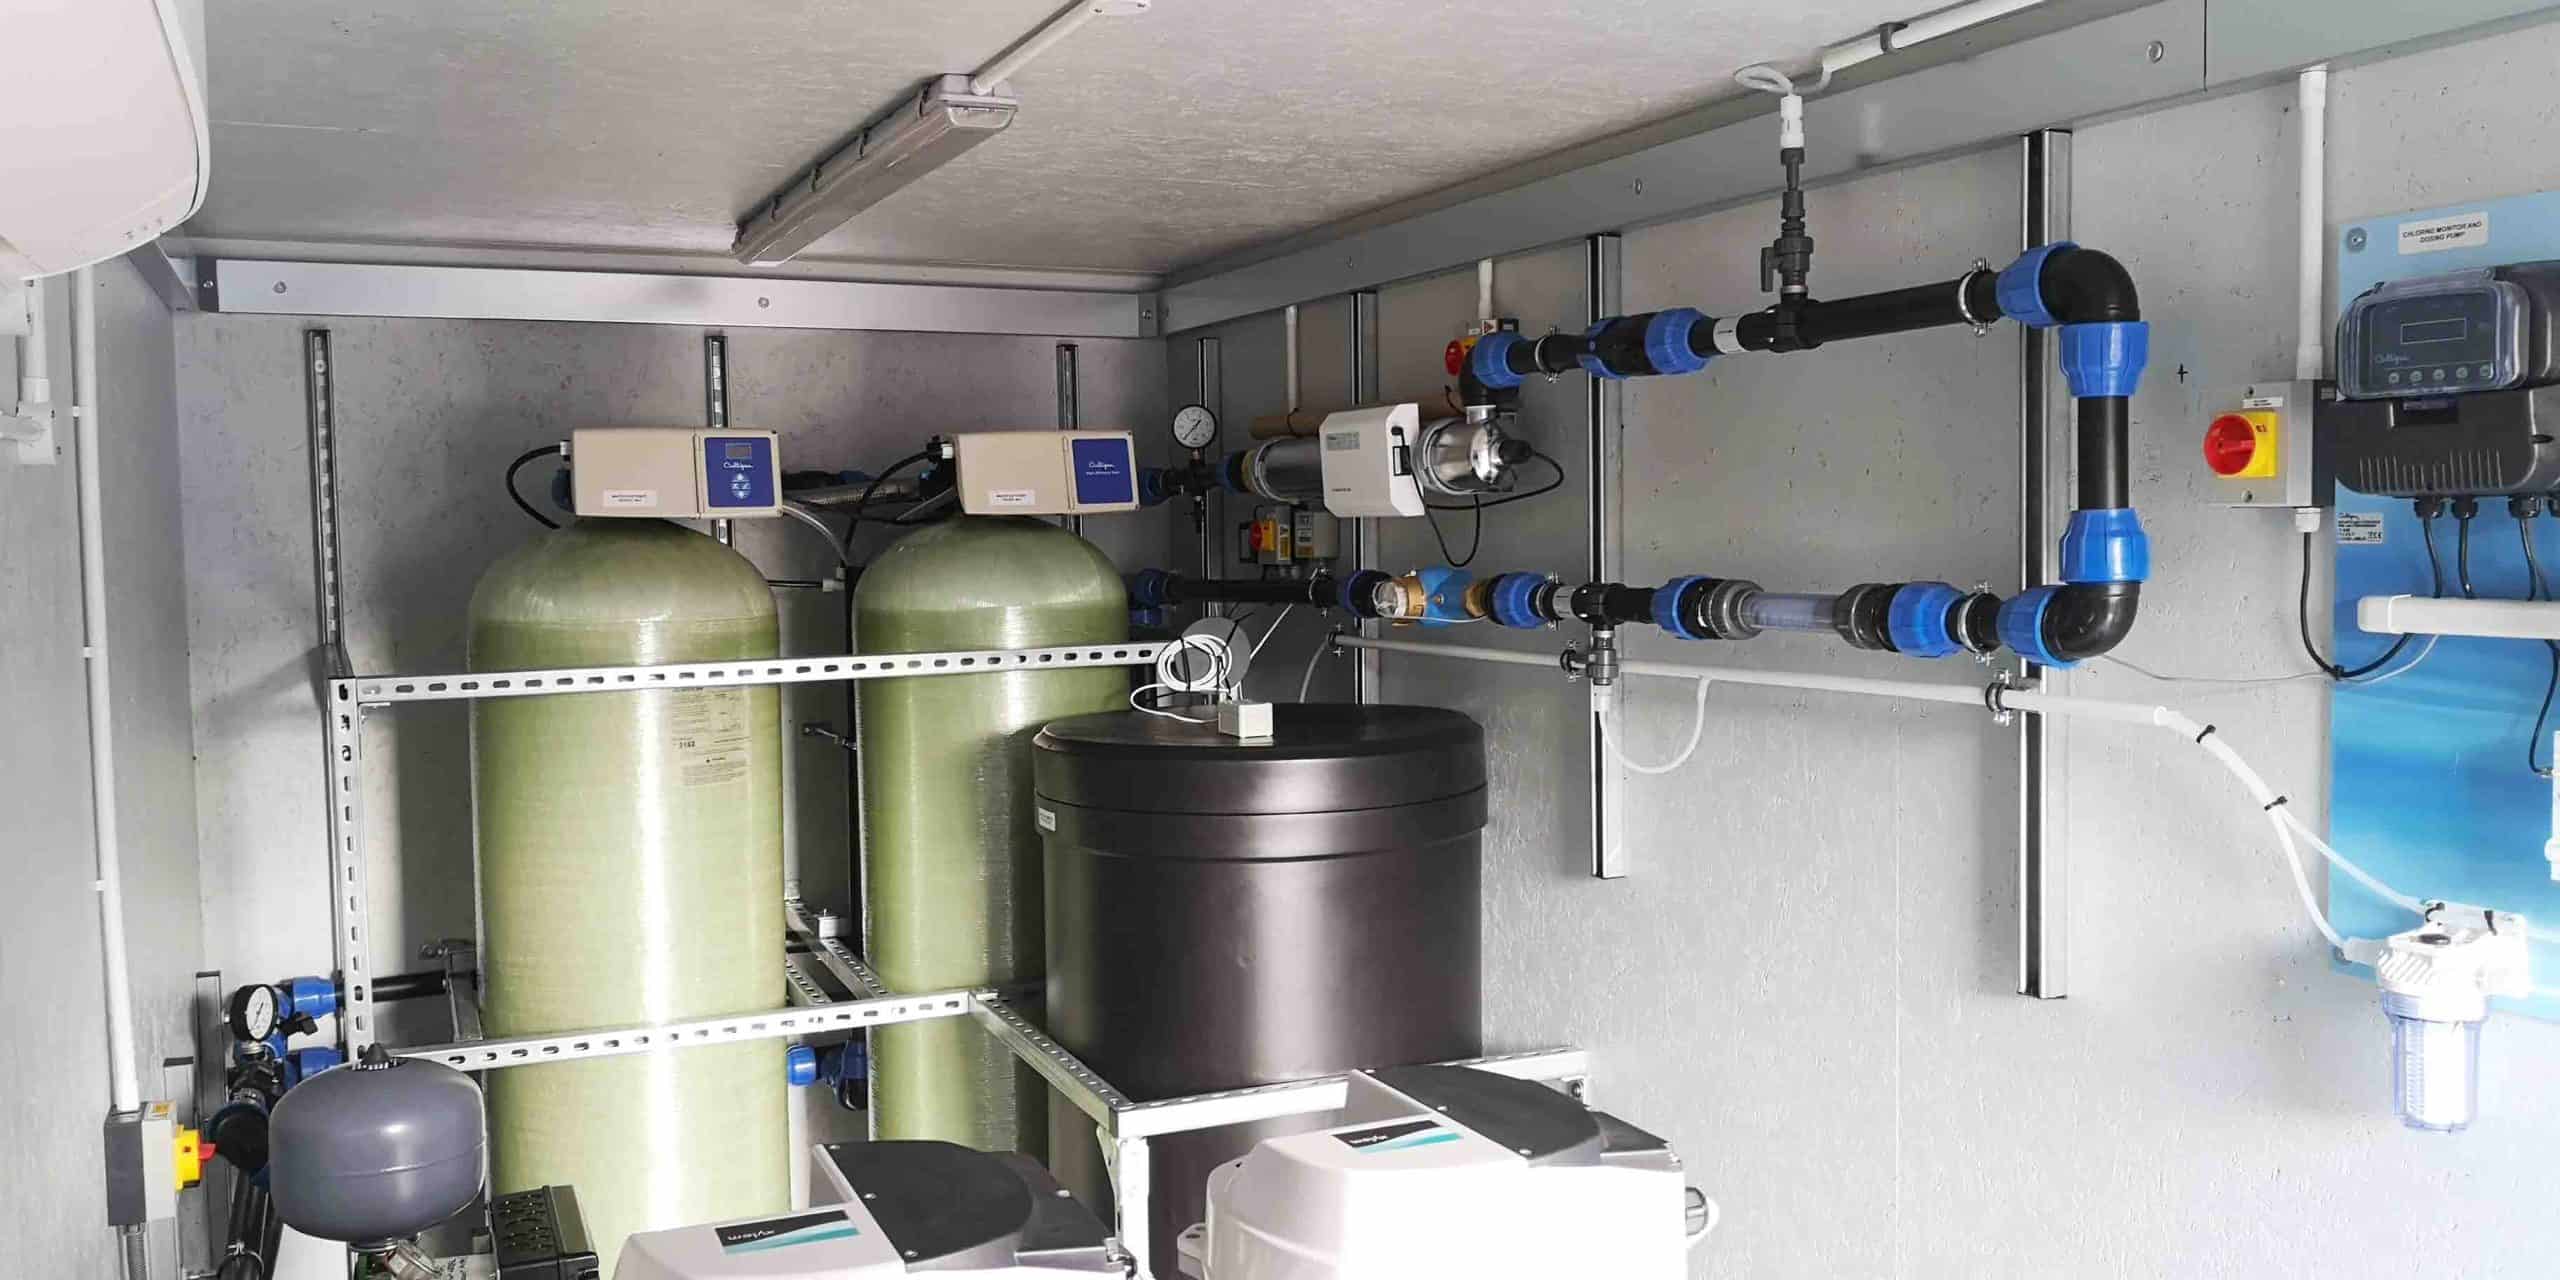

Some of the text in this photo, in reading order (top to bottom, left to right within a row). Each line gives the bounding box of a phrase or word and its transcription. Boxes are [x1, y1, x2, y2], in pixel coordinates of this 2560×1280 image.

[2402, 227, 2435, 239] CHLORINE
[2436, 223, 2467, 233] MONITOR
[2419, 230, 2467, 243] DOSING PUMP
